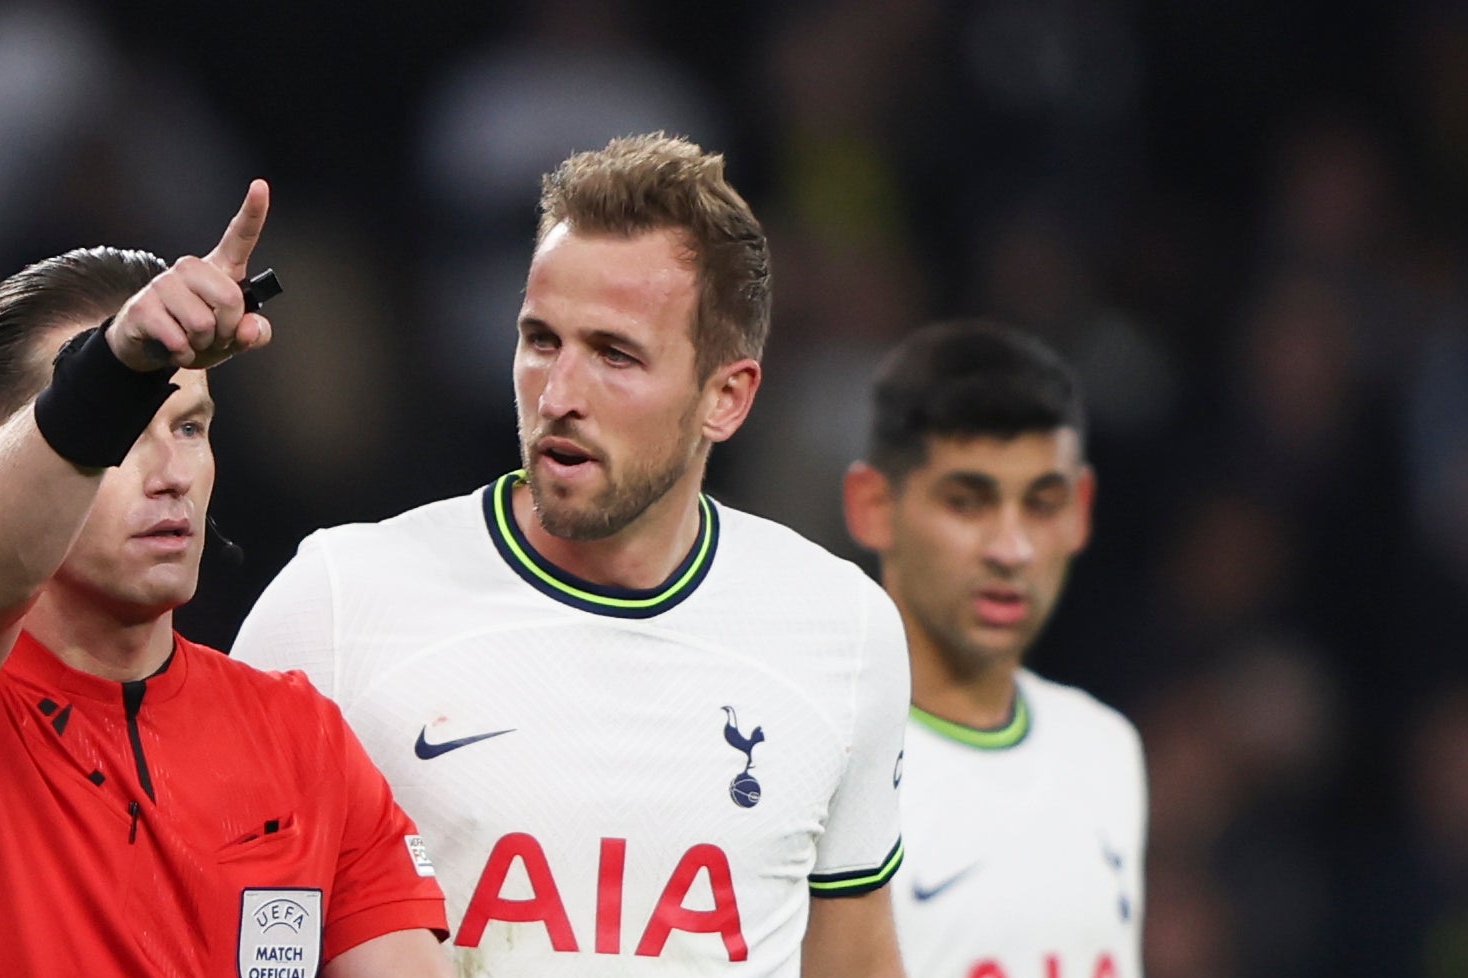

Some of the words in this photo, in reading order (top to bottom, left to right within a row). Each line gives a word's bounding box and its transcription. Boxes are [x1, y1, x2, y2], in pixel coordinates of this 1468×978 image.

[453, 831, 749, 963] AIA
[256, 905, 304, 929] UEFA
[255, 946, 303, 961] MATCH
